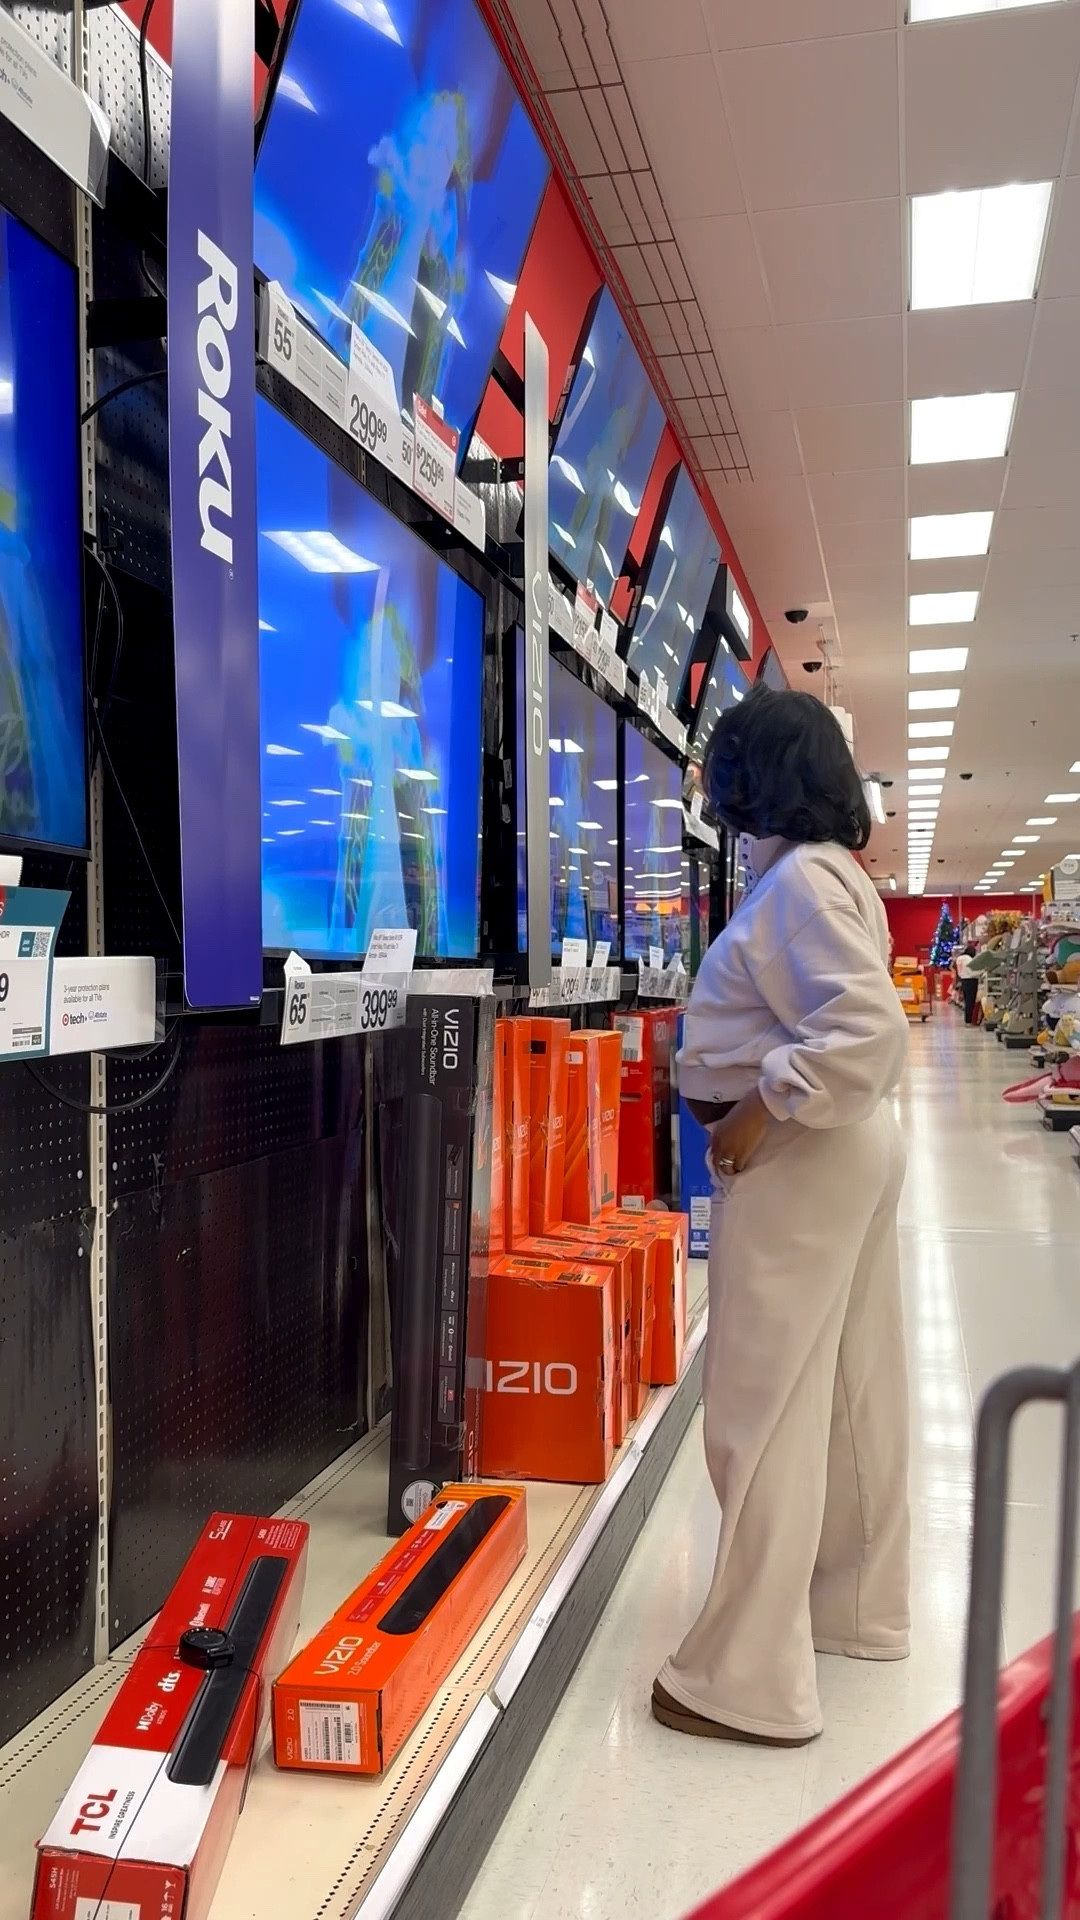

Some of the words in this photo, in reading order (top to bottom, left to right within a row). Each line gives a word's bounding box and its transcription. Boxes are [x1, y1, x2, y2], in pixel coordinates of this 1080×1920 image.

[532, 571, 543, 756] VIZIO
[430, 1008, 439, 1046] All-in-One
[443, 1008, 459, 1069] VIZIO
[429, 1047, 438, 1086] Soundbar
[486, 1360, 578, 1395] IZIO
[314, 1636, 363, 1675] VIZIO
[357, 1641, 382, 1666] Soundbar
[70, 1789, 118, 1835] TCL
[108, 1818, 123, 1840] INSPIRE
[117, 1790, 136, 1819] GREATNESS
